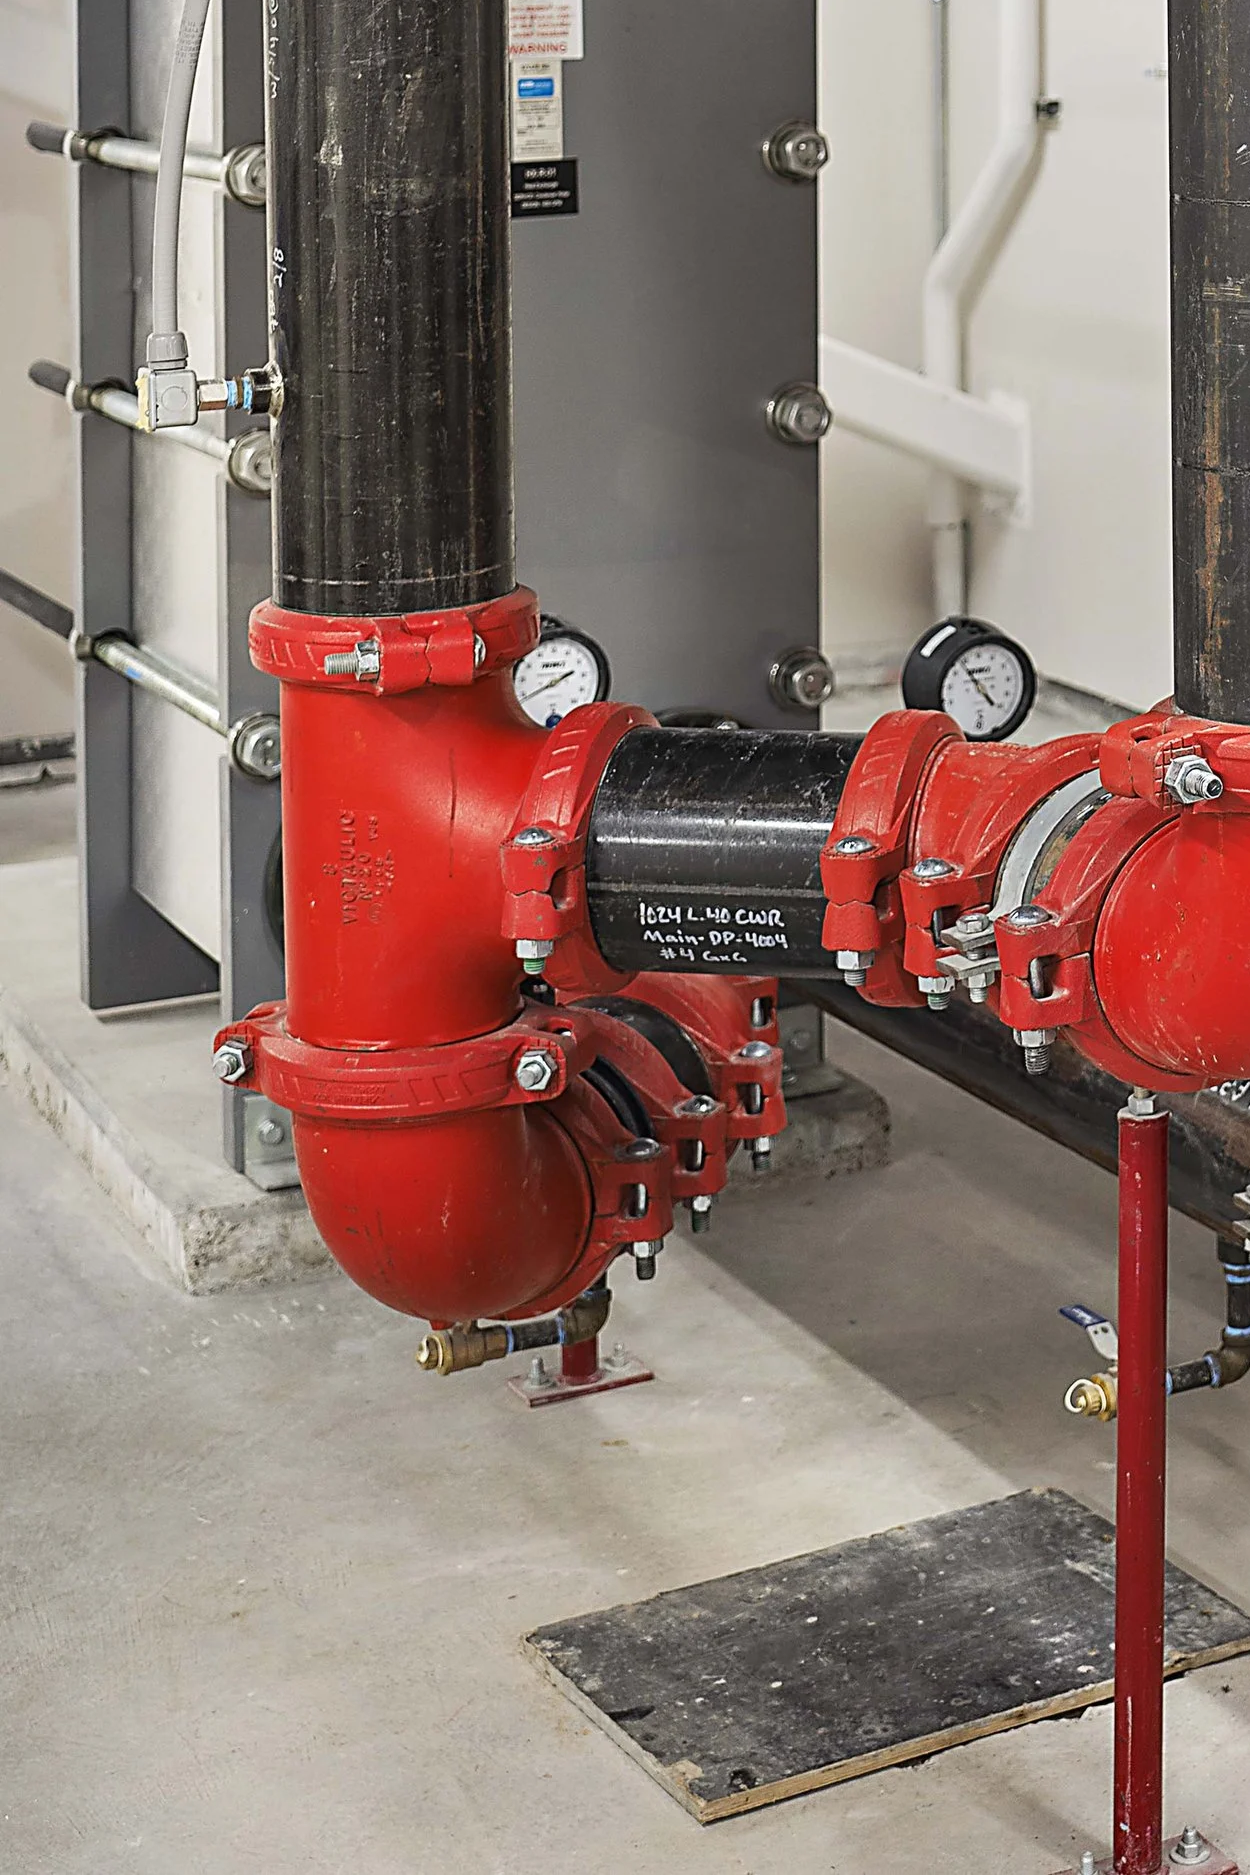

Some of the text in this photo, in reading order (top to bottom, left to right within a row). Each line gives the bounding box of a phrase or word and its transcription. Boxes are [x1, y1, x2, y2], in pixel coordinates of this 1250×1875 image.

[338, 810, 359, 926] VICTAULIC
[640, 901, 785, 927] 1024 L.40 CWR
